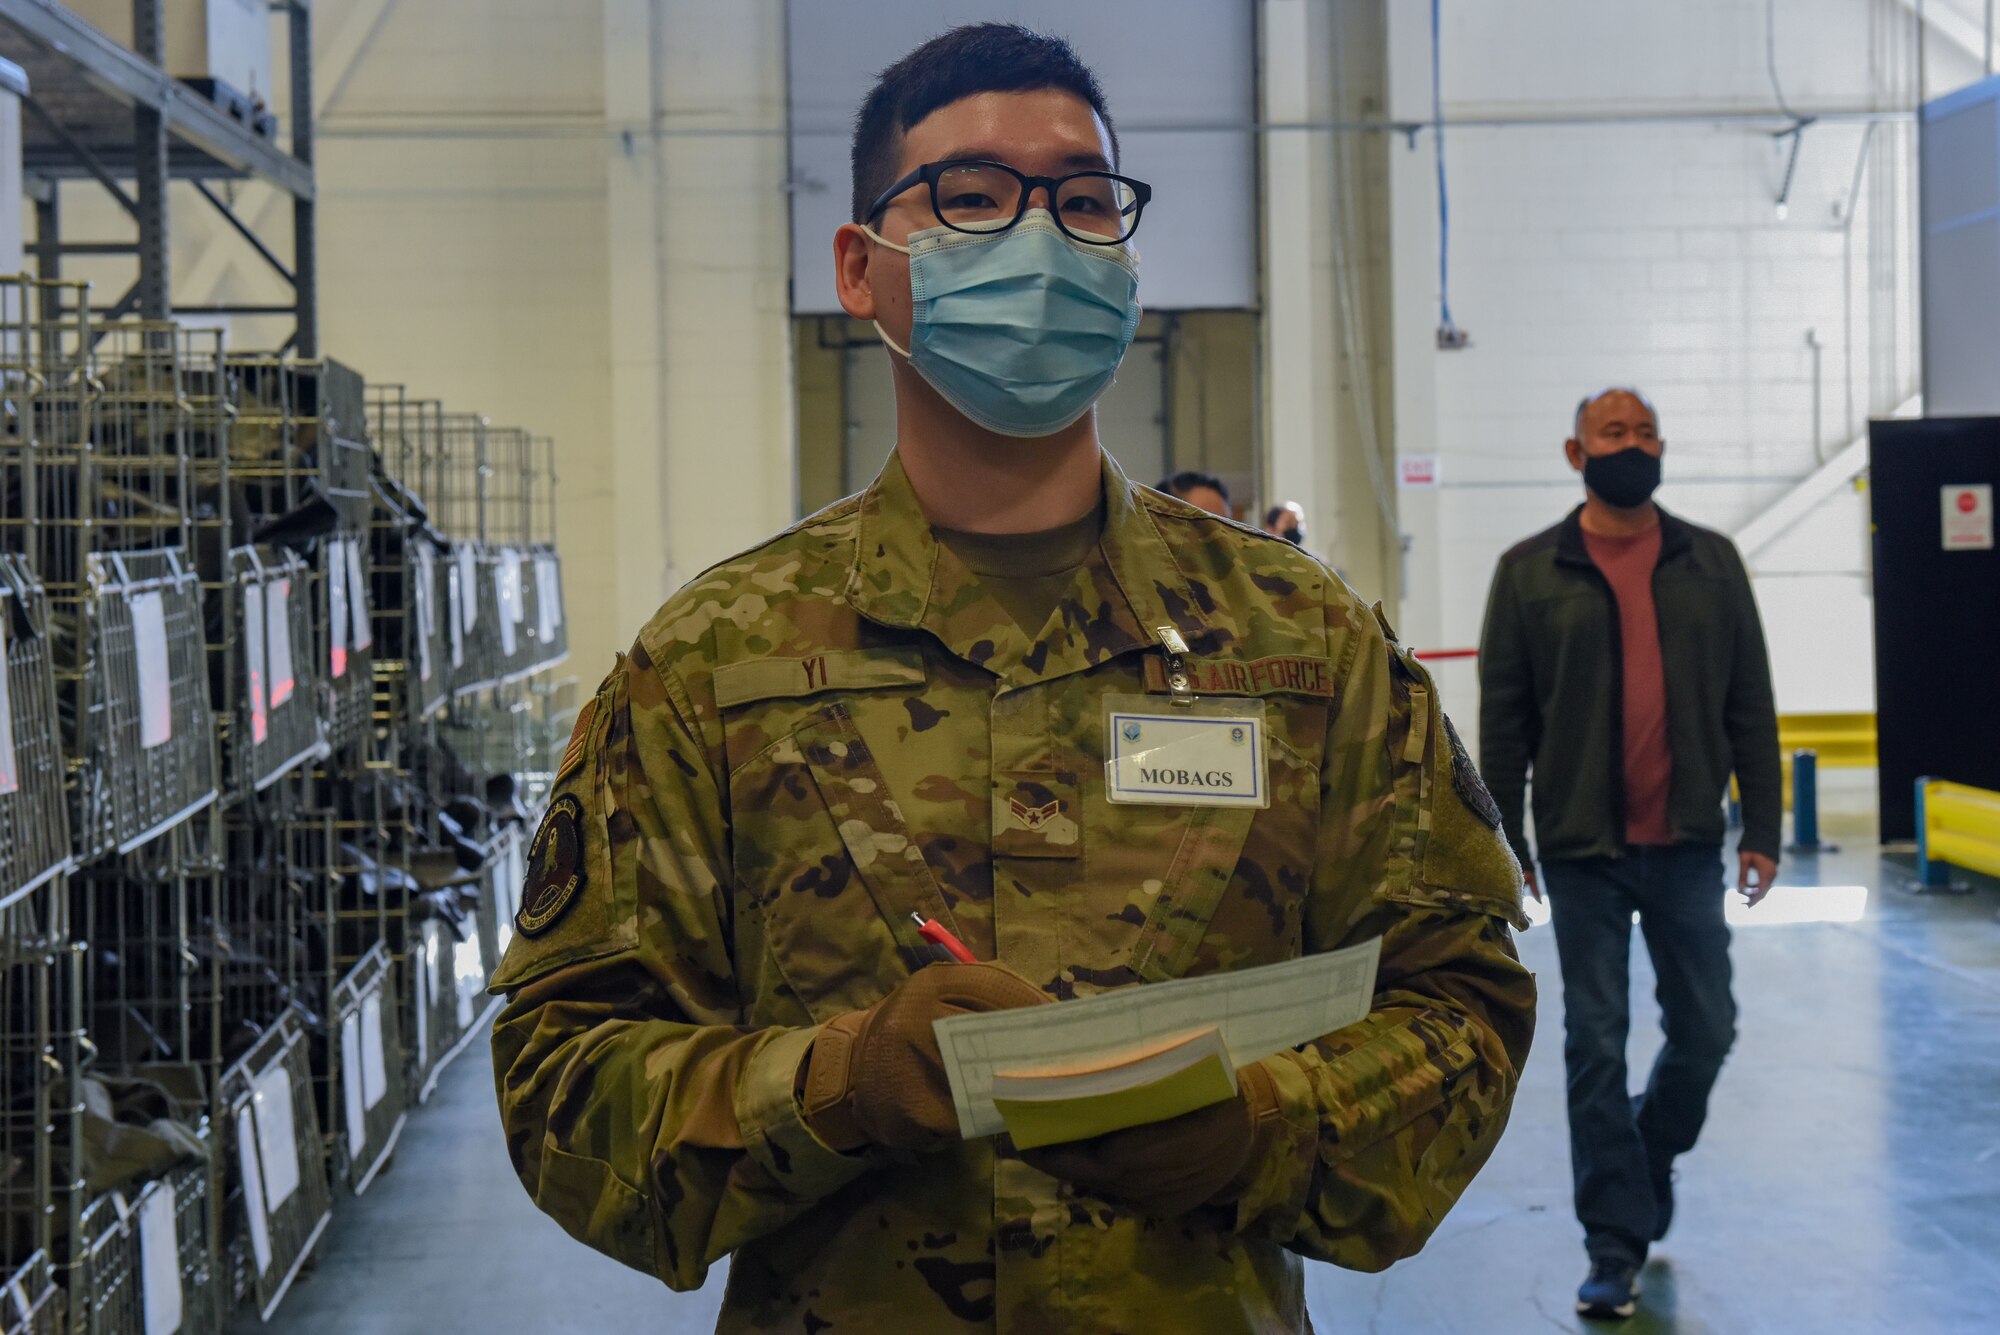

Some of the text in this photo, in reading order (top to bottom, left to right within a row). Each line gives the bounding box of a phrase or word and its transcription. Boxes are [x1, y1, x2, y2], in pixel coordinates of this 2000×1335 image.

[802, 657, 827, 688] YI
[1209, 662, 1248, 692] AIR
[1250, 658, 1329, 693] FORCE
[1139, 768, 1233, 788] MOBAGS
